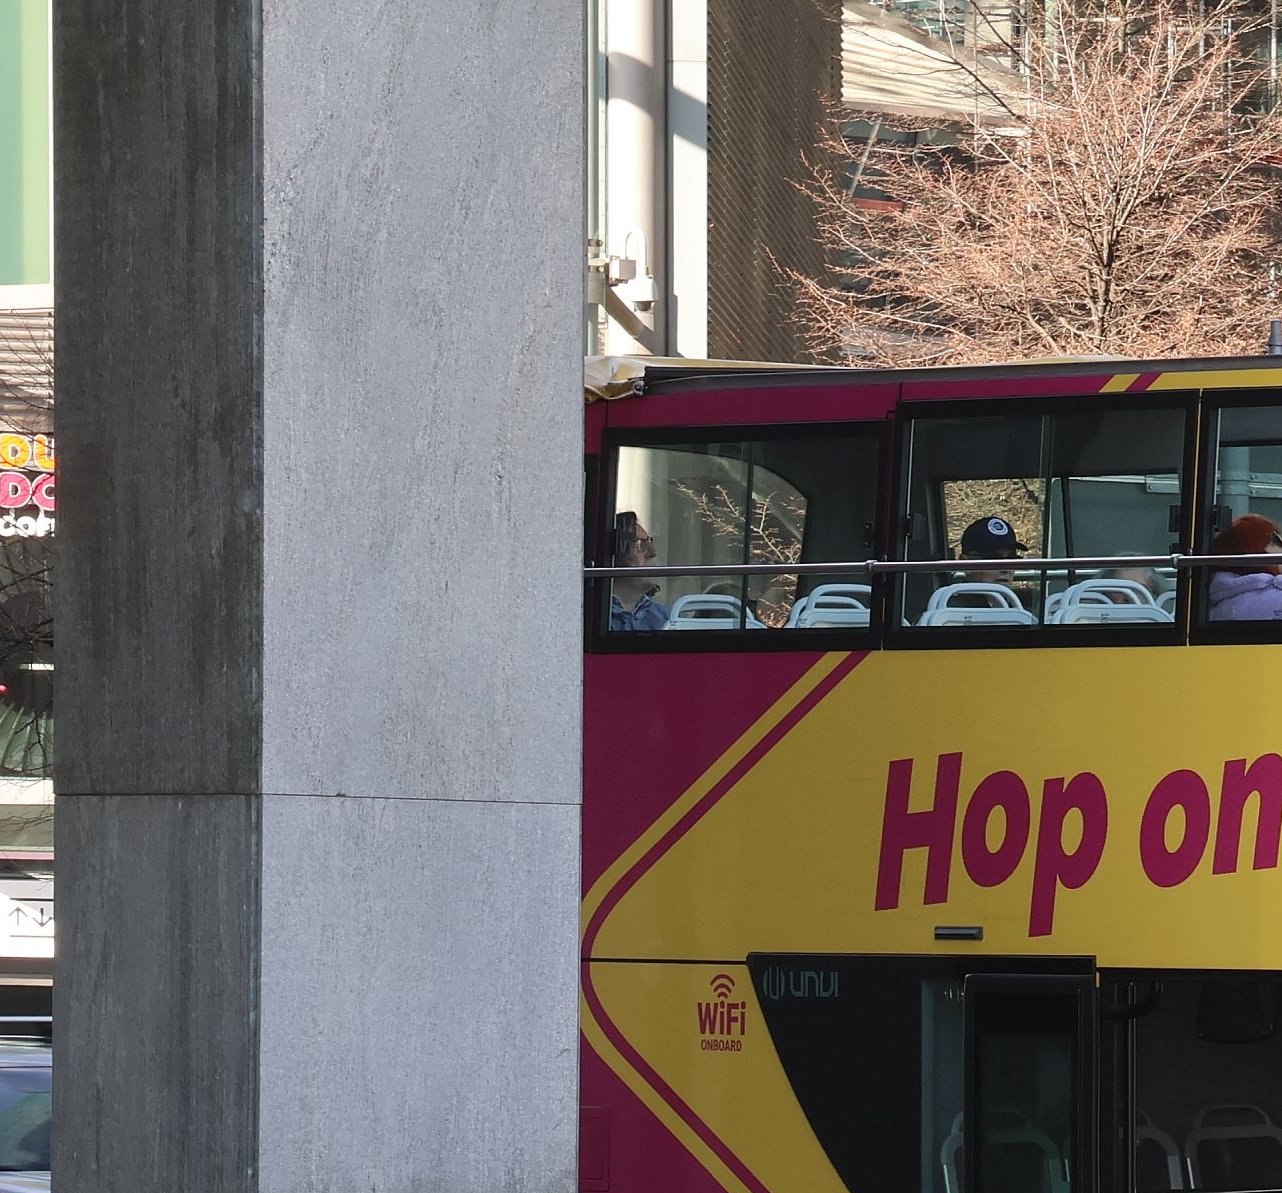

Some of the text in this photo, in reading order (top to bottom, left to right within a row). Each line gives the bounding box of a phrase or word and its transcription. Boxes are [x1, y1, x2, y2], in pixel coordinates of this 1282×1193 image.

[874, 752, 1108, 938] Hop
[697, 1000, 747, 1036] WiFi
[701, 1038, 743, 1052] ONBOARD
